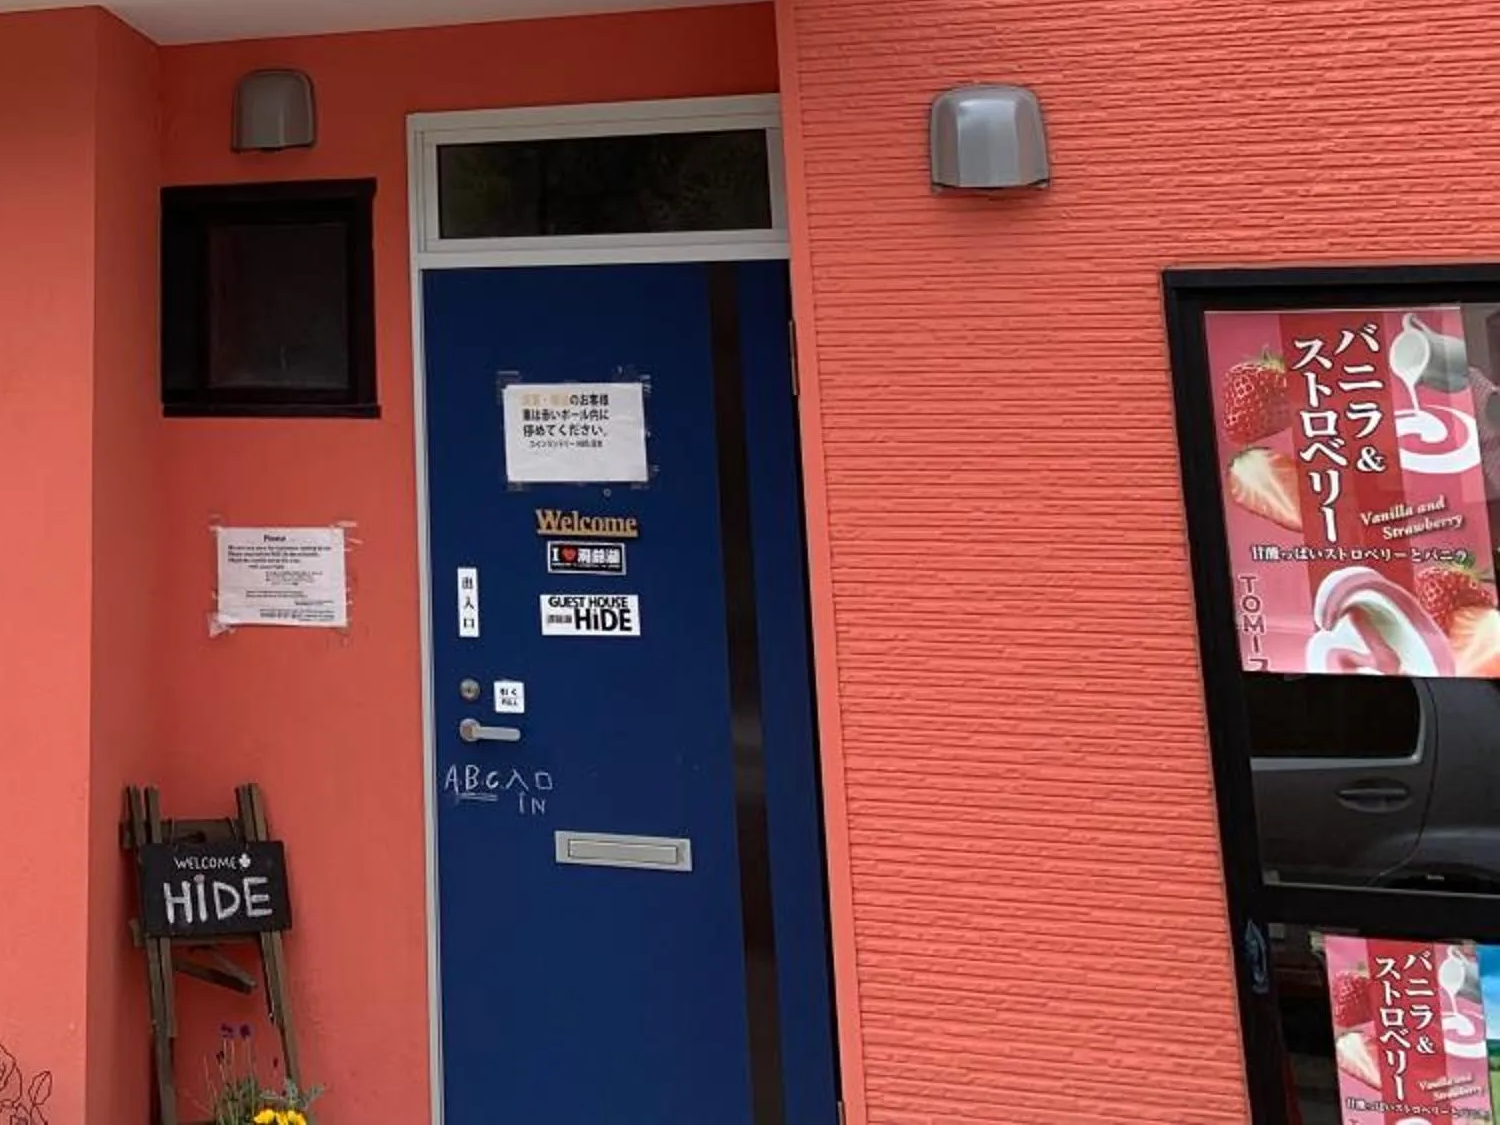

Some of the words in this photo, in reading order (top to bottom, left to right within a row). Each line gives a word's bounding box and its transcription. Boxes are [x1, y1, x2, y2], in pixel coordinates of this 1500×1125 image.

[1334, 323, 1385, 472] バニラ&
[1293, 338, 1348, 543] ストロベリー
[536, 508, 638, 535] Welcome
[1360, 503, 1413, 527] Vanilla
[1417, 494, 1446, 515] and
[1383, 514, 1464, 541] Strawberry
[547, 596, 586, 608] GUEST
[588, 596, 629, 608] HOUSE
[173, 855, 238, 870] WELCOME
[1374, 956, 1411, 1101] ストロベリー
